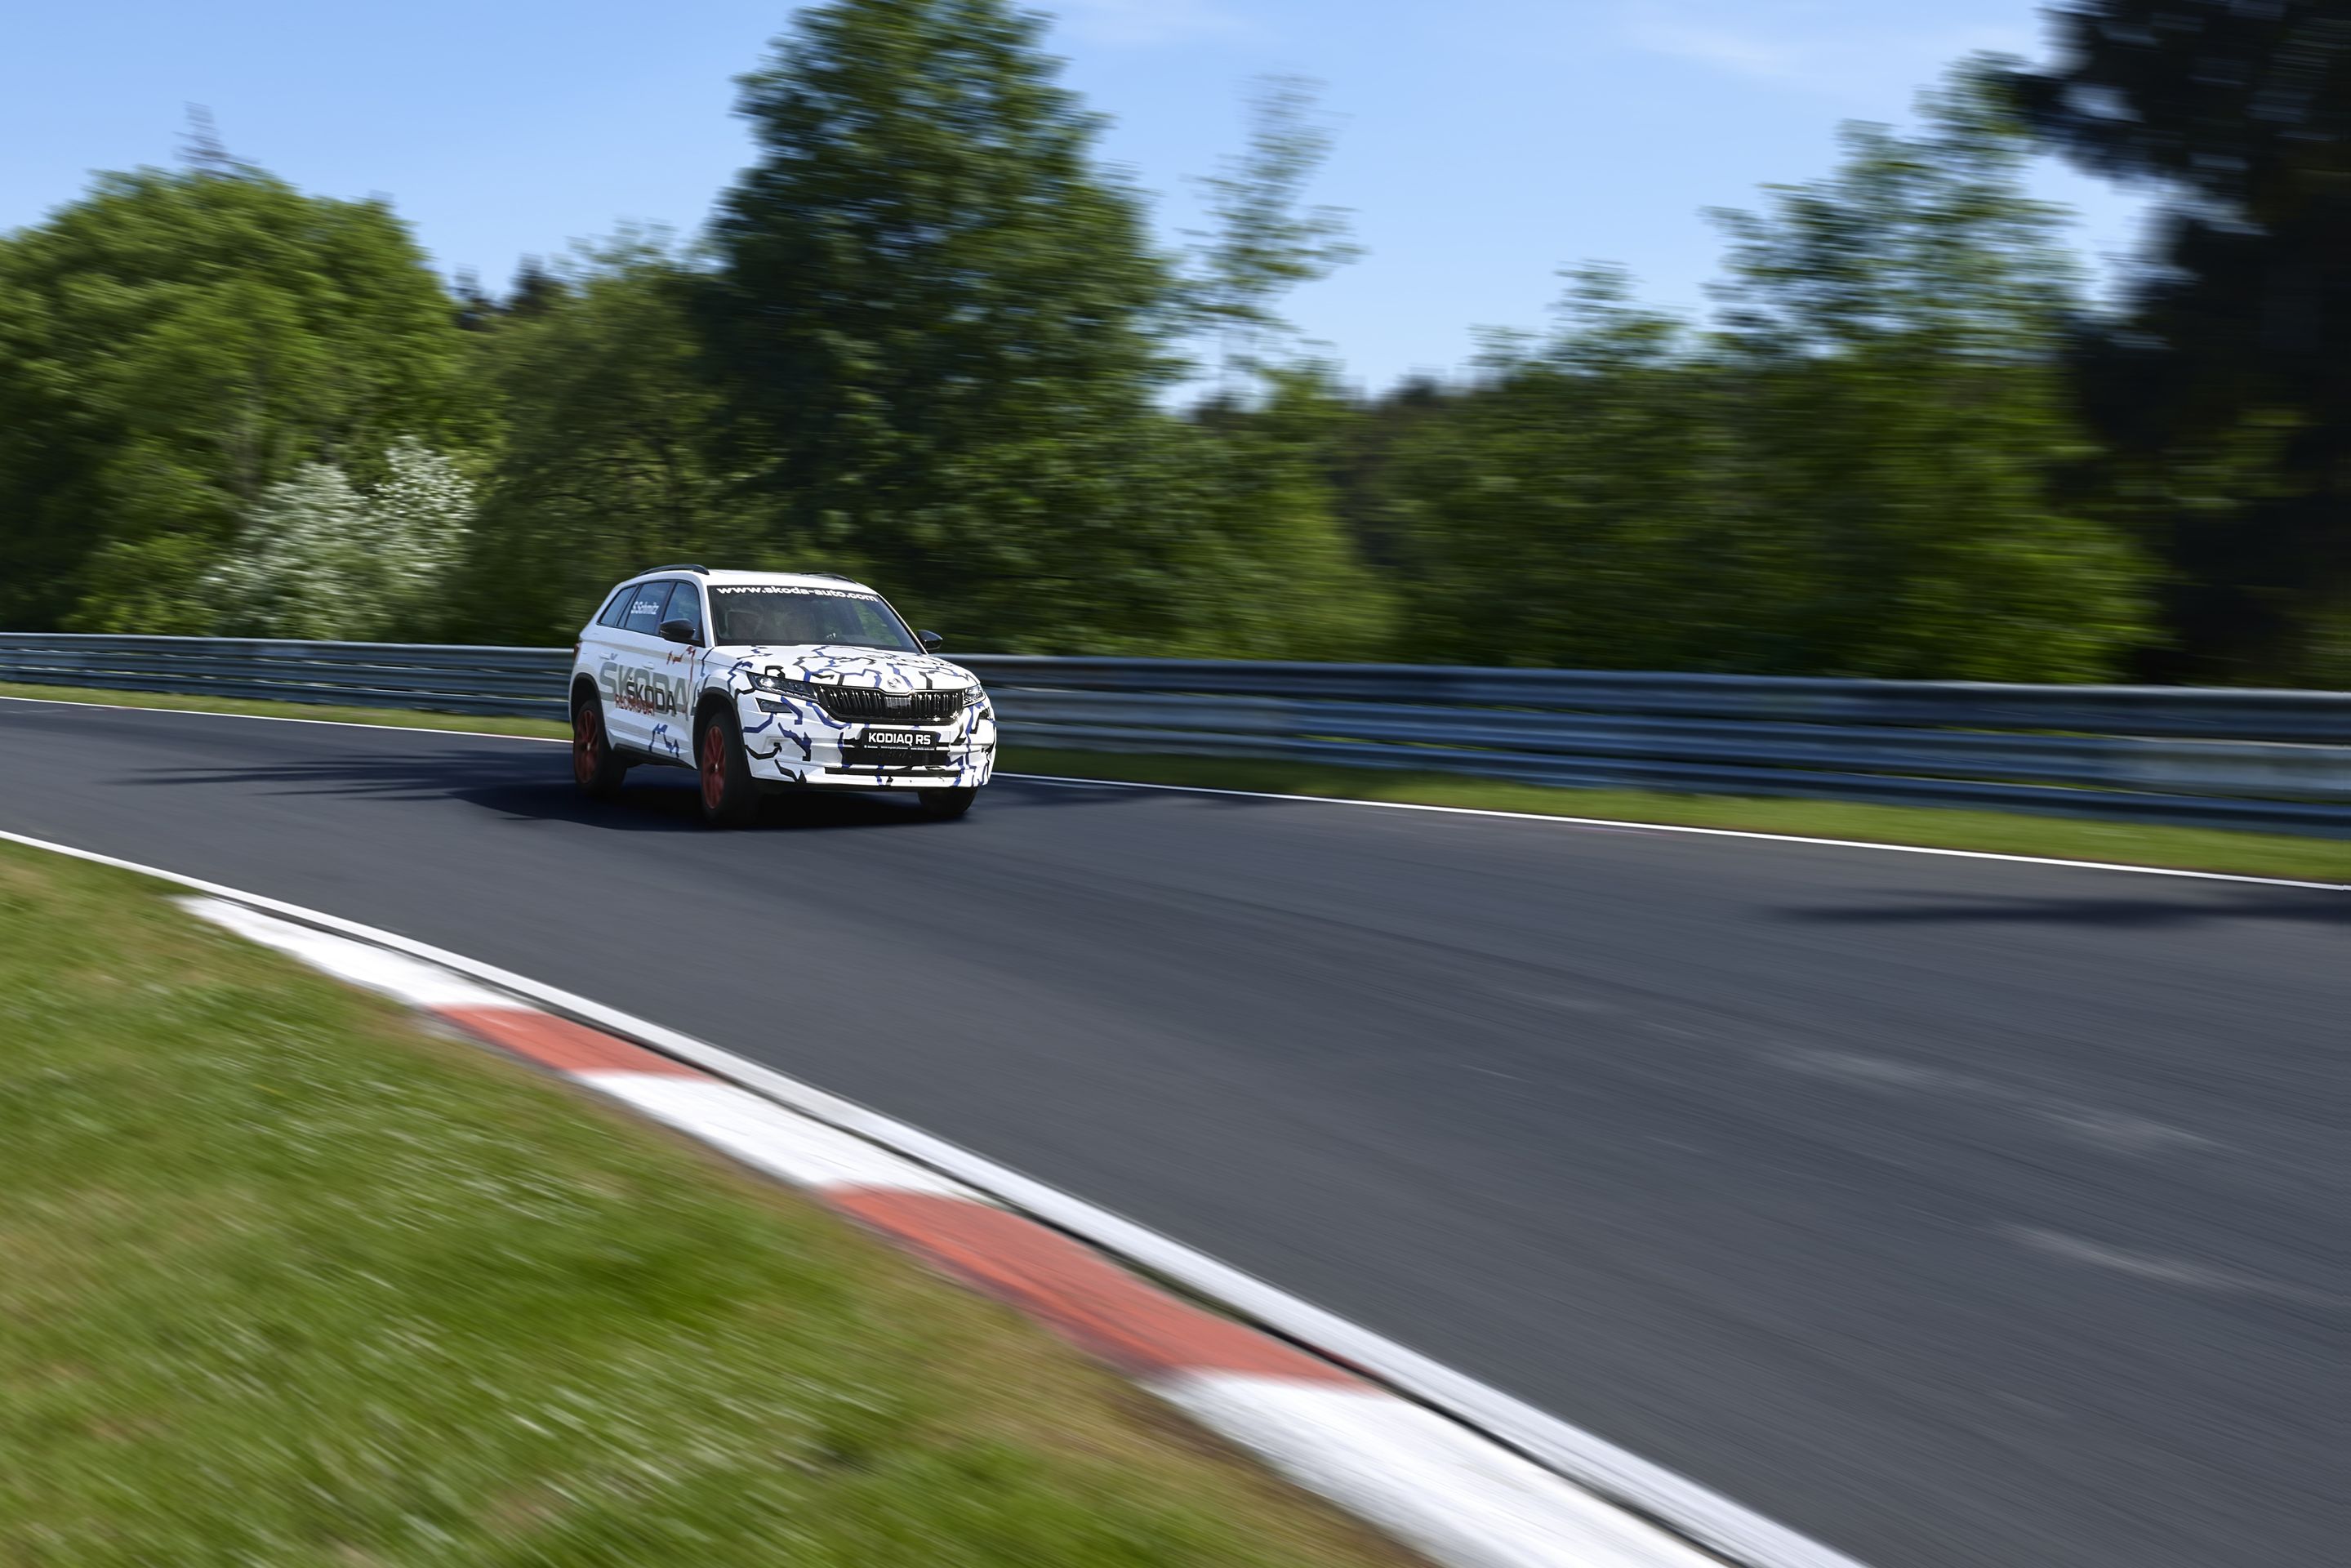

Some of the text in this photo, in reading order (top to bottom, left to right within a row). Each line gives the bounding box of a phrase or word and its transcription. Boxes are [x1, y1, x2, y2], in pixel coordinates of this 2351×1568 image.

[717, 586, 879, 603] www.skoda-auto.com
[868, 732, 931, 746] KODIAQ RS
